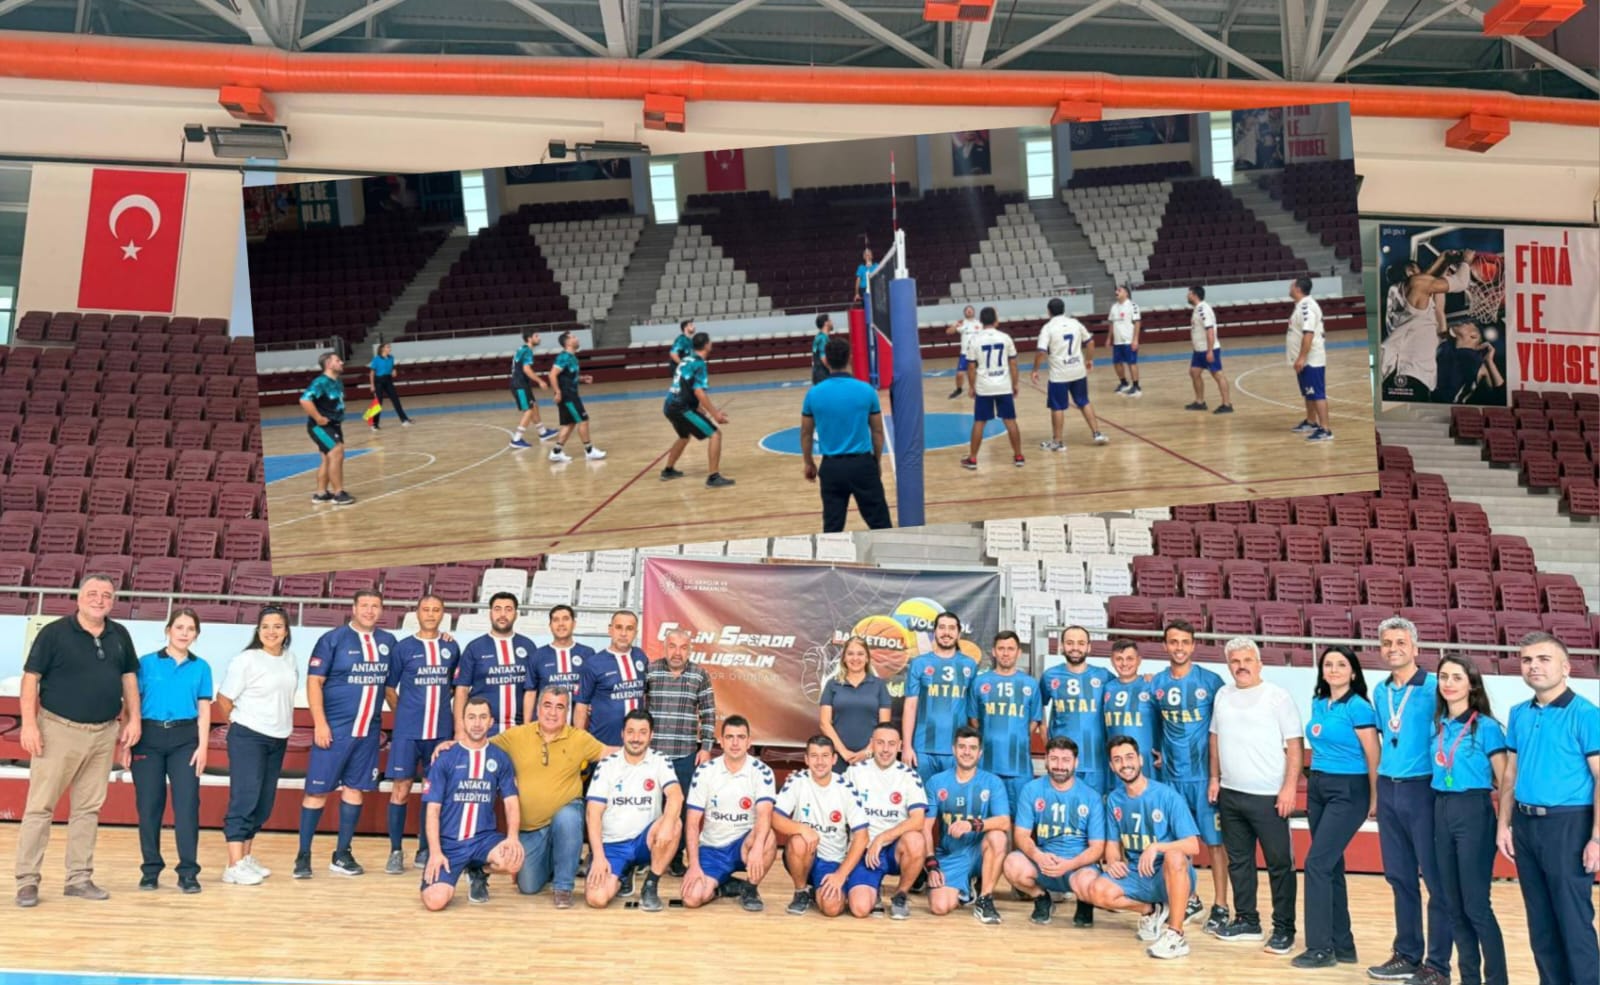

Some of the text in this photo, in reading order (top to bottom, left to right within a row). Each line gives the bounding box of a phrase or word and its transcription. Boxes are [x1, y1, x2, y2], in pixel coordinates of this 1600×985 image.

[1063, 334, 1074, 355] 7
[982, 343, 1004, 368] 77
[1516, 339, 1600, 385] YÜKSE
[835, 630, 904, 649] BAETBOL
[941, 666, 954, 681] 3
[997, 682, 1014, 697] 15
[1067, 678, 1080, 696] 8
[1167, 687, 1181, 705] 6
[1055, 699, 1097, 712] MTAL
[1114, 691, 1128, 706] 9
[1051, 802, 1066, 823] 11
[1131, 813, 1141, 833] 7
